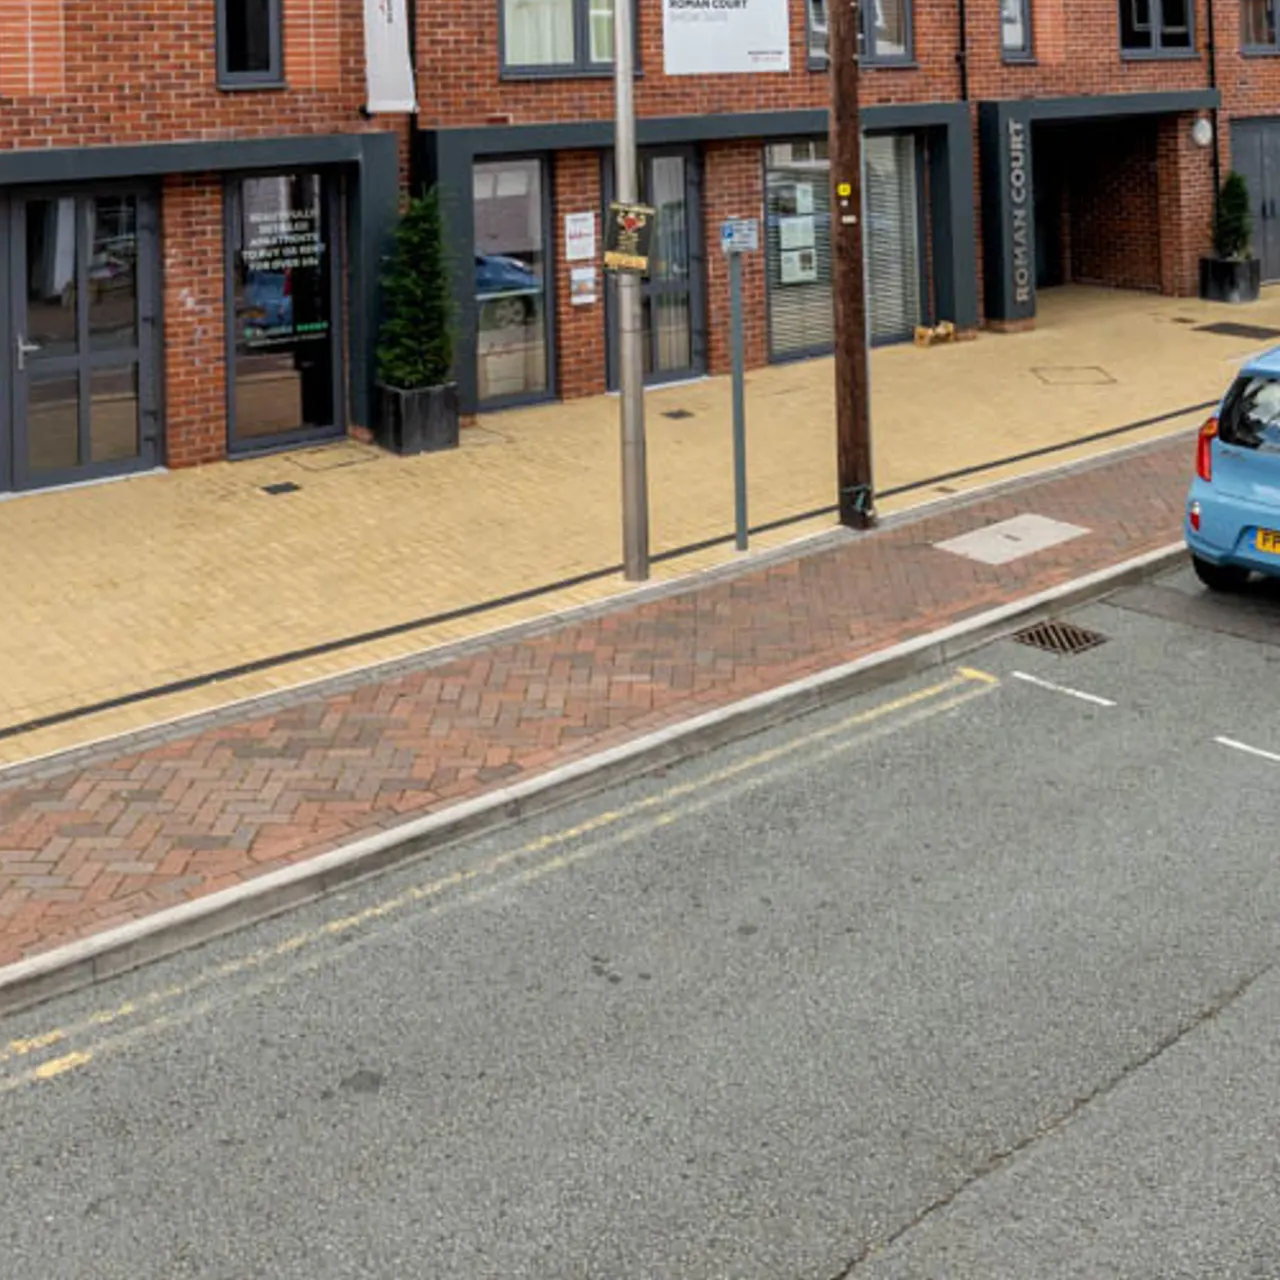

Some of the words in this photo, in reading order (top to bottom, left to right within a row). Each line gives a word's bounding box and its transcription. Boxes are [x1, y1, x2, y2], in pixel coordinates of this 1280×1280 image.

[669, 0, 709, 9] ROMAN
[712, 0, 748, 9] COURT
[1009, 118, 1026, 203] COURT
[1014, 208, 1029, 302] ROMAN
